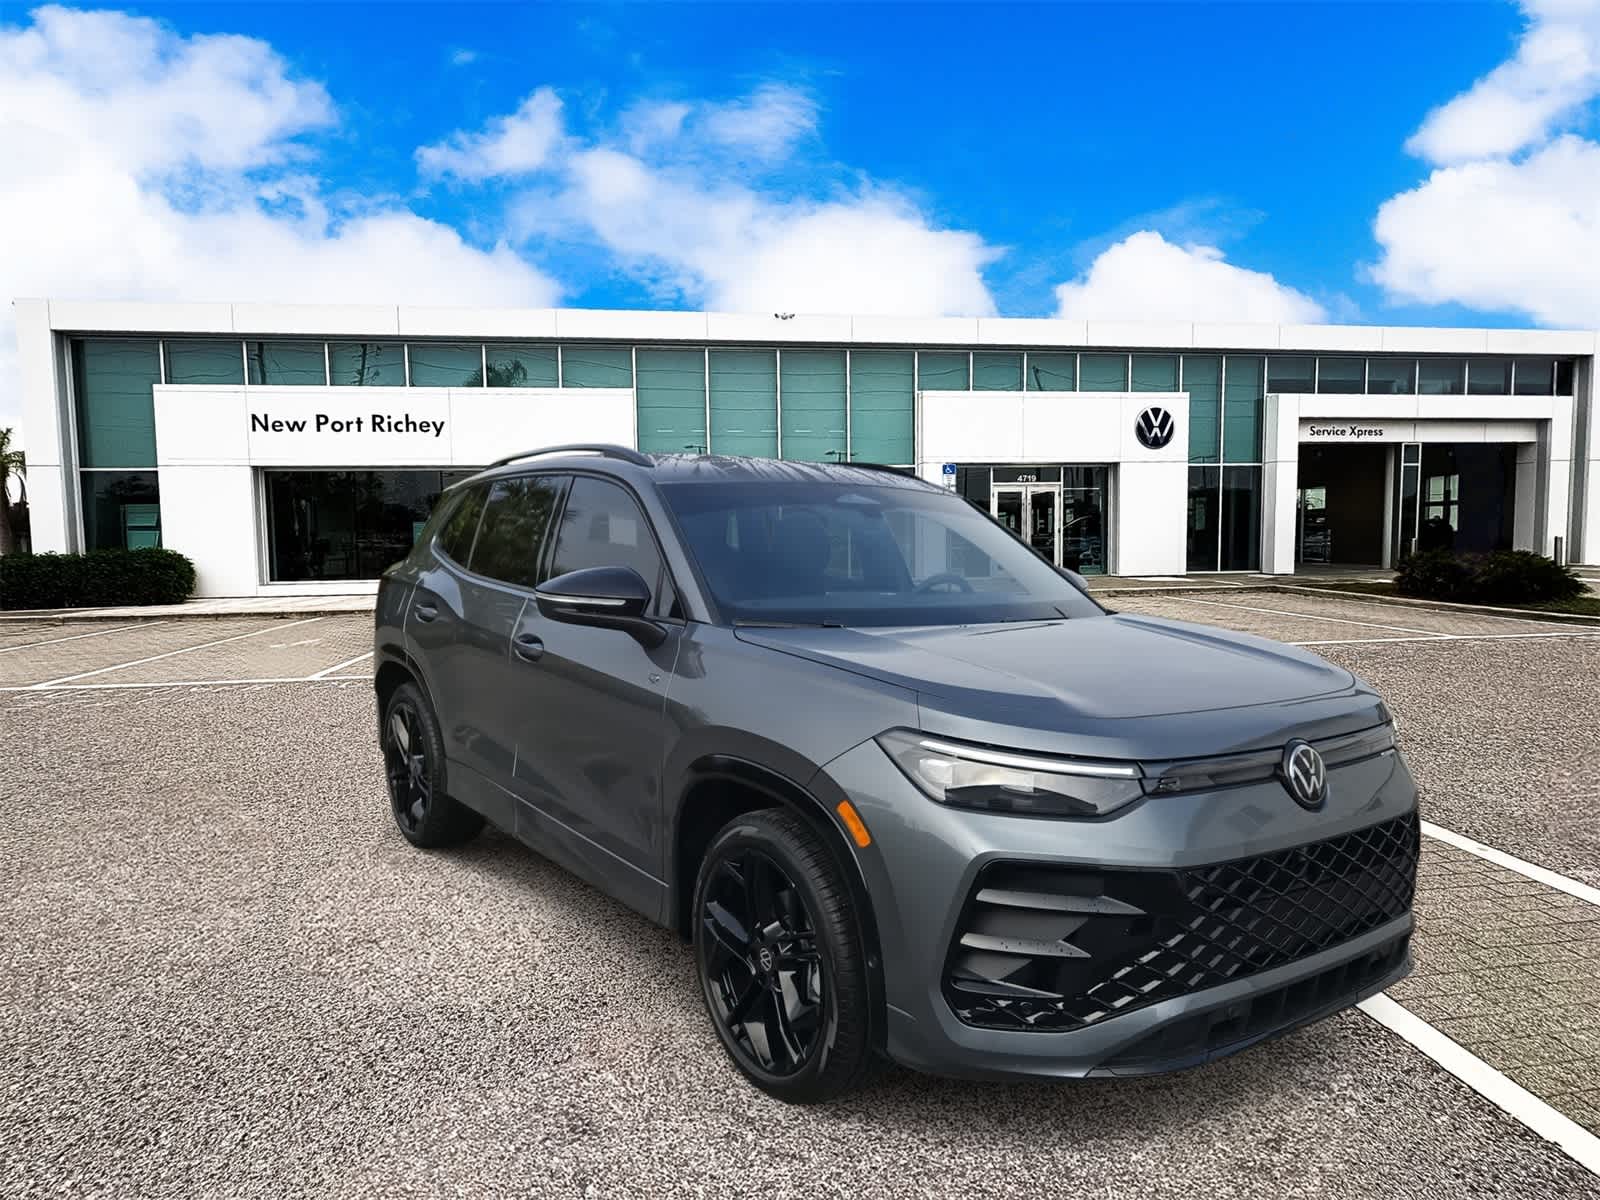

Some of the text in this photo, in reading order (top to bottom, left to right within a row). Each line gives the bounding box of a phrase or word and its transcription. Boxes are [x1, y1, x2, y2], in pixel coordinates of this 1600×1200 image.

[251, 413, 445, 437] New Port Richey
[1310, 426, 1384, 438] Service Xpress
